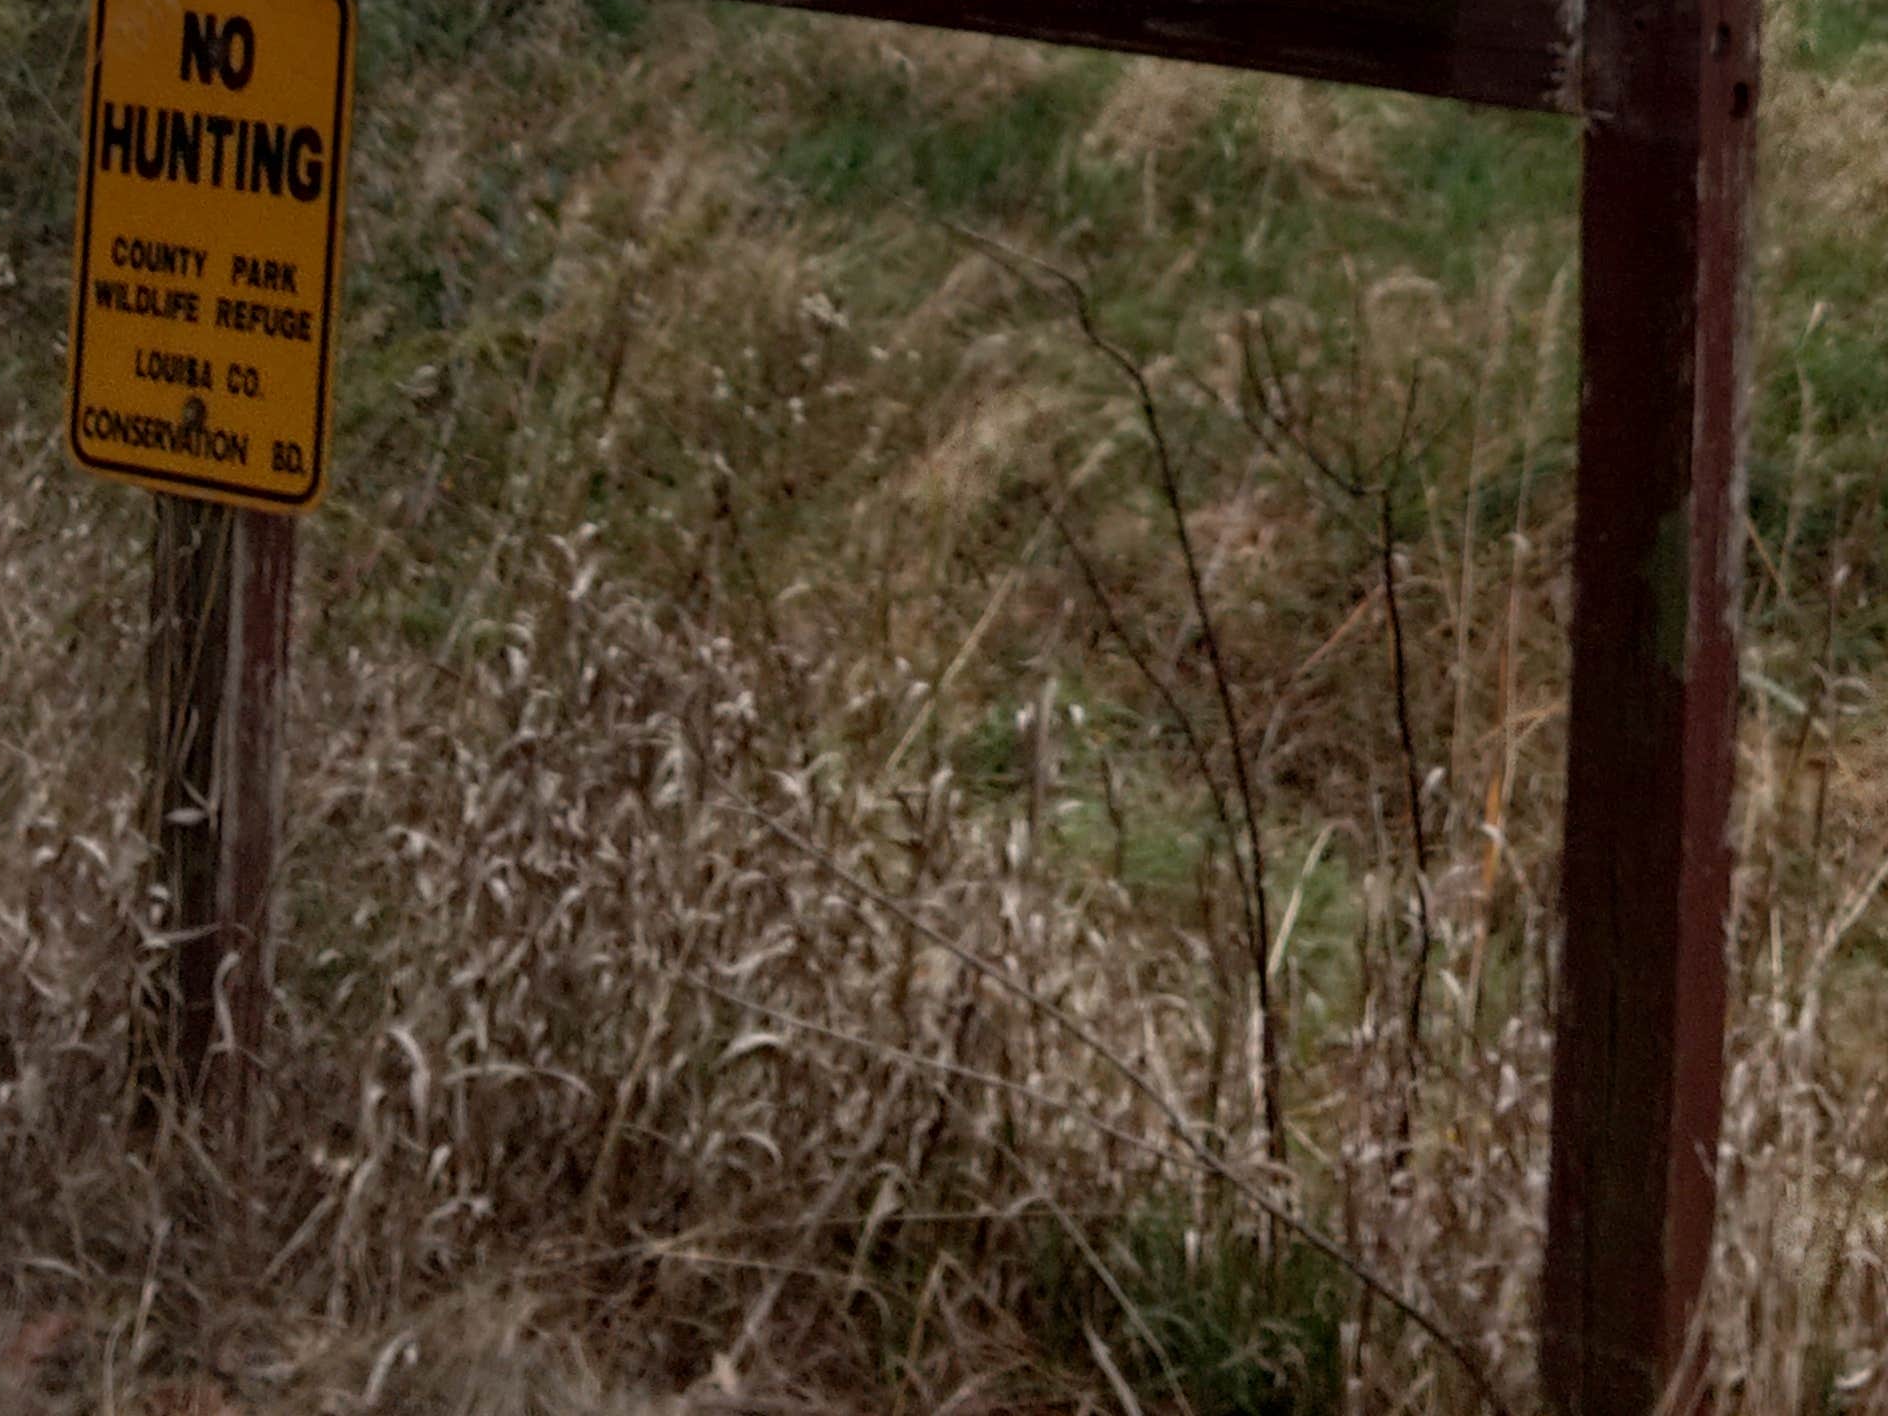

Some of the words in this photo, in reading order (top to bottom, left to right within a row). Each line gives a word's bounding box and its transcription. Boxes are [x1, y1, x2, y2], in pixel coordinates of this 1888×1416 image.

[180, 10, 256, 91] NO
[100, 102, 324, 202] HUNTING
[112, 236, 208, 278] COUNTY
[231, 255, 298, 294] PARK
[94, 280, 200, 324] WILDLIFE
[215, 297, 313, 342] REFUGE
[135, 349, 213, 390] LOUISA
[82, 406, 249, 466] CONSERVATION
